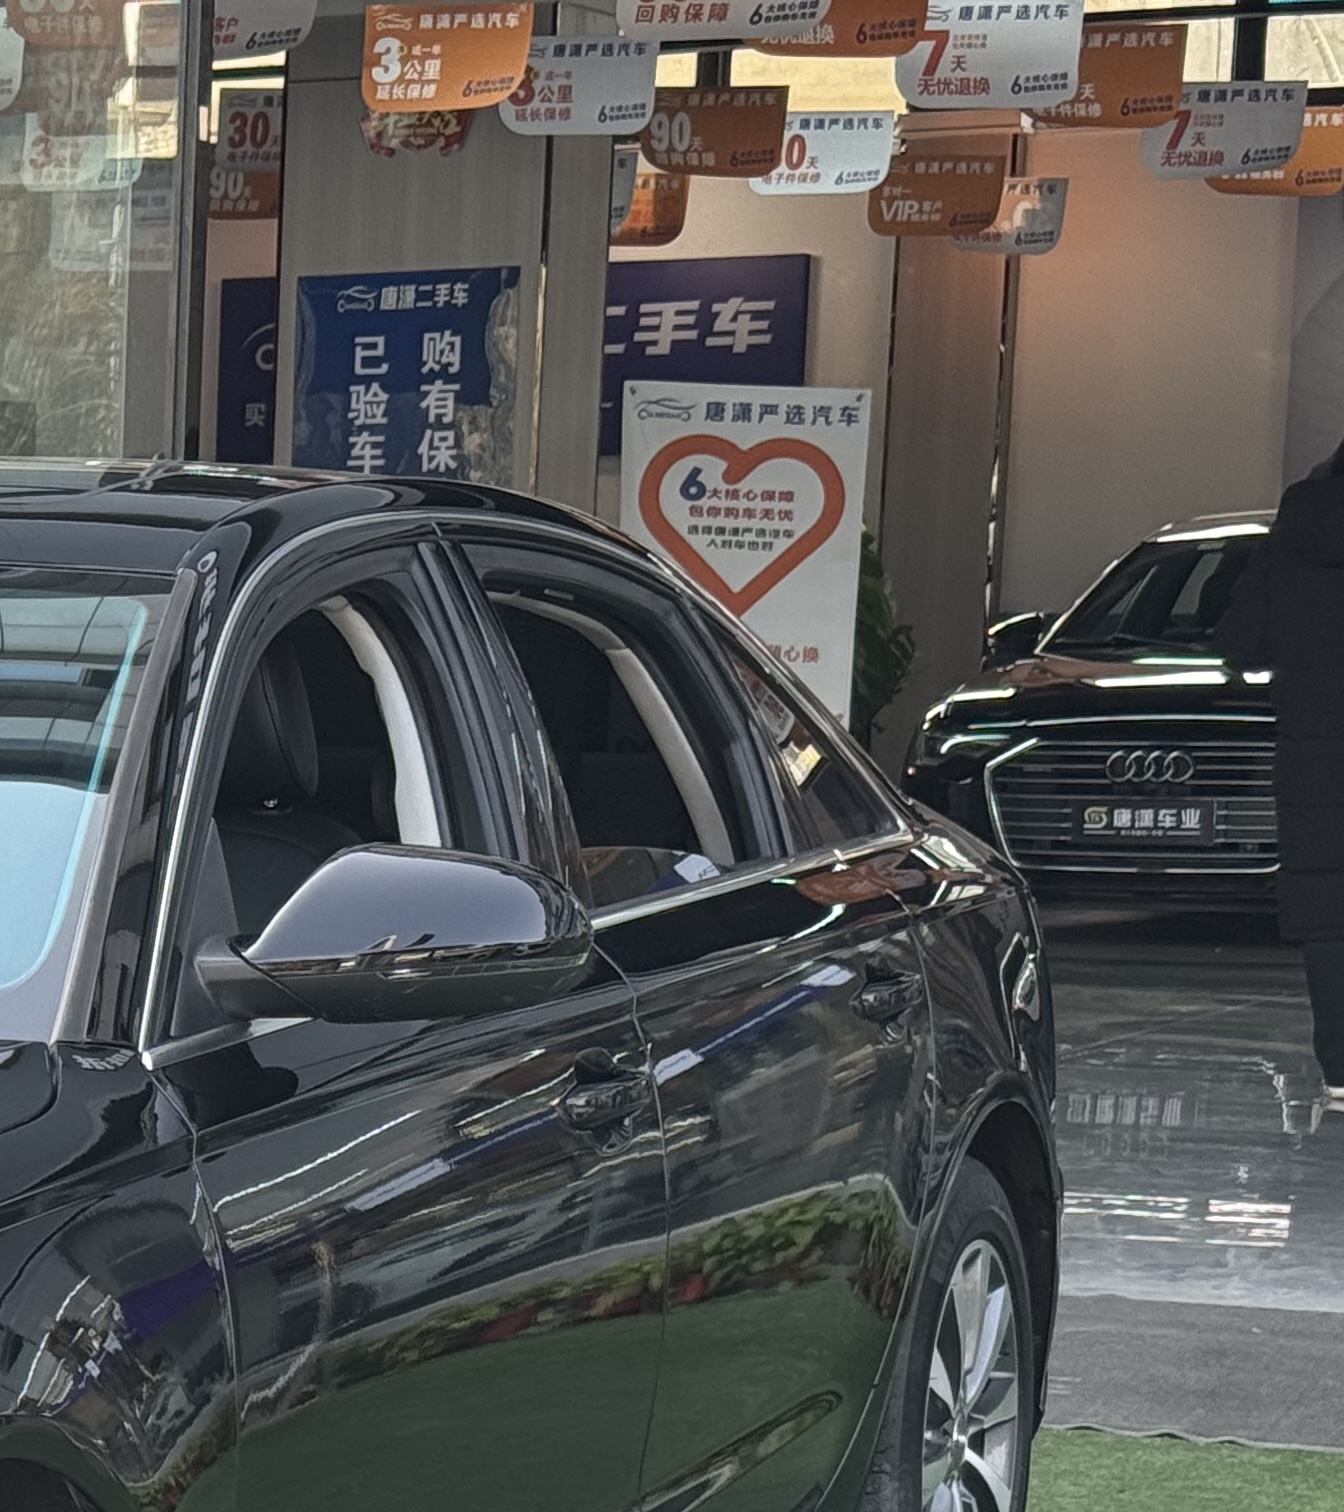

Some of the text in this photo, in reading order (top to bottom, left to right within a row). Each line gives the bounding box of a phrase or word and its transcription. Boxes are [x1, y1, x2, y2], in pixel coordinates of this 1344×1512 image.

[418, 12, 520, 30] 唐潇严选汽车
[634, 3, 730, 24] 回购保障
[749, 3, 763, 26] 6
[957, 4, 1070, 22] 唐潇严选汽车
[856, 22, 868, 44] 6
[1080, 31, 1175, 48] 潇严选汽车
[371, 36, 403, 84] 3
[552, 42, 648, 58] 唐潇严选汽车
[919, 30, 952, 77] 7
[403, 59, 442, 81] 公里
[949, 55, 968, 74] 天
[375, 83, 438, 100] 延长保修
[462, 80, 474, 98] 6
[537, 84, 574, 104] 公里
[916, 77, 991, 97] 无忧退换
[1010, 73, 1023, 96] 6
[1079, 83, 1096, 100] 天
[1197, 87, 1296, 104] 唐潇严选汽车
[514, 107, 573, 123] 延长保修
[597, 105, 609, 124] 6
[1119, 96, 1131, 117] 6
[227, 110, 270, 149] 30
[649, 111, 692, 152] 90
[1166, 109, 1192, 151] 7
[1191, 131, 1206, 148] 天
[1160, 150, 1225, 168] 无忧退换
[1240, 148, 1251, 166] 6
[209, 167, 244, 199] 90
[879, 200, 919, 222] VIP
[379, 282, 470, 312] 唐潇二手车
[347, 335, 390, 474] 已验车
[417, 329, 462, 473] 购有保
[703, 400, 861, 428] 唐潇严选汽车
[687, 504, 795, 523] 包你购车无忧
[1113, 808, 1202, 830] 唐潇车业
